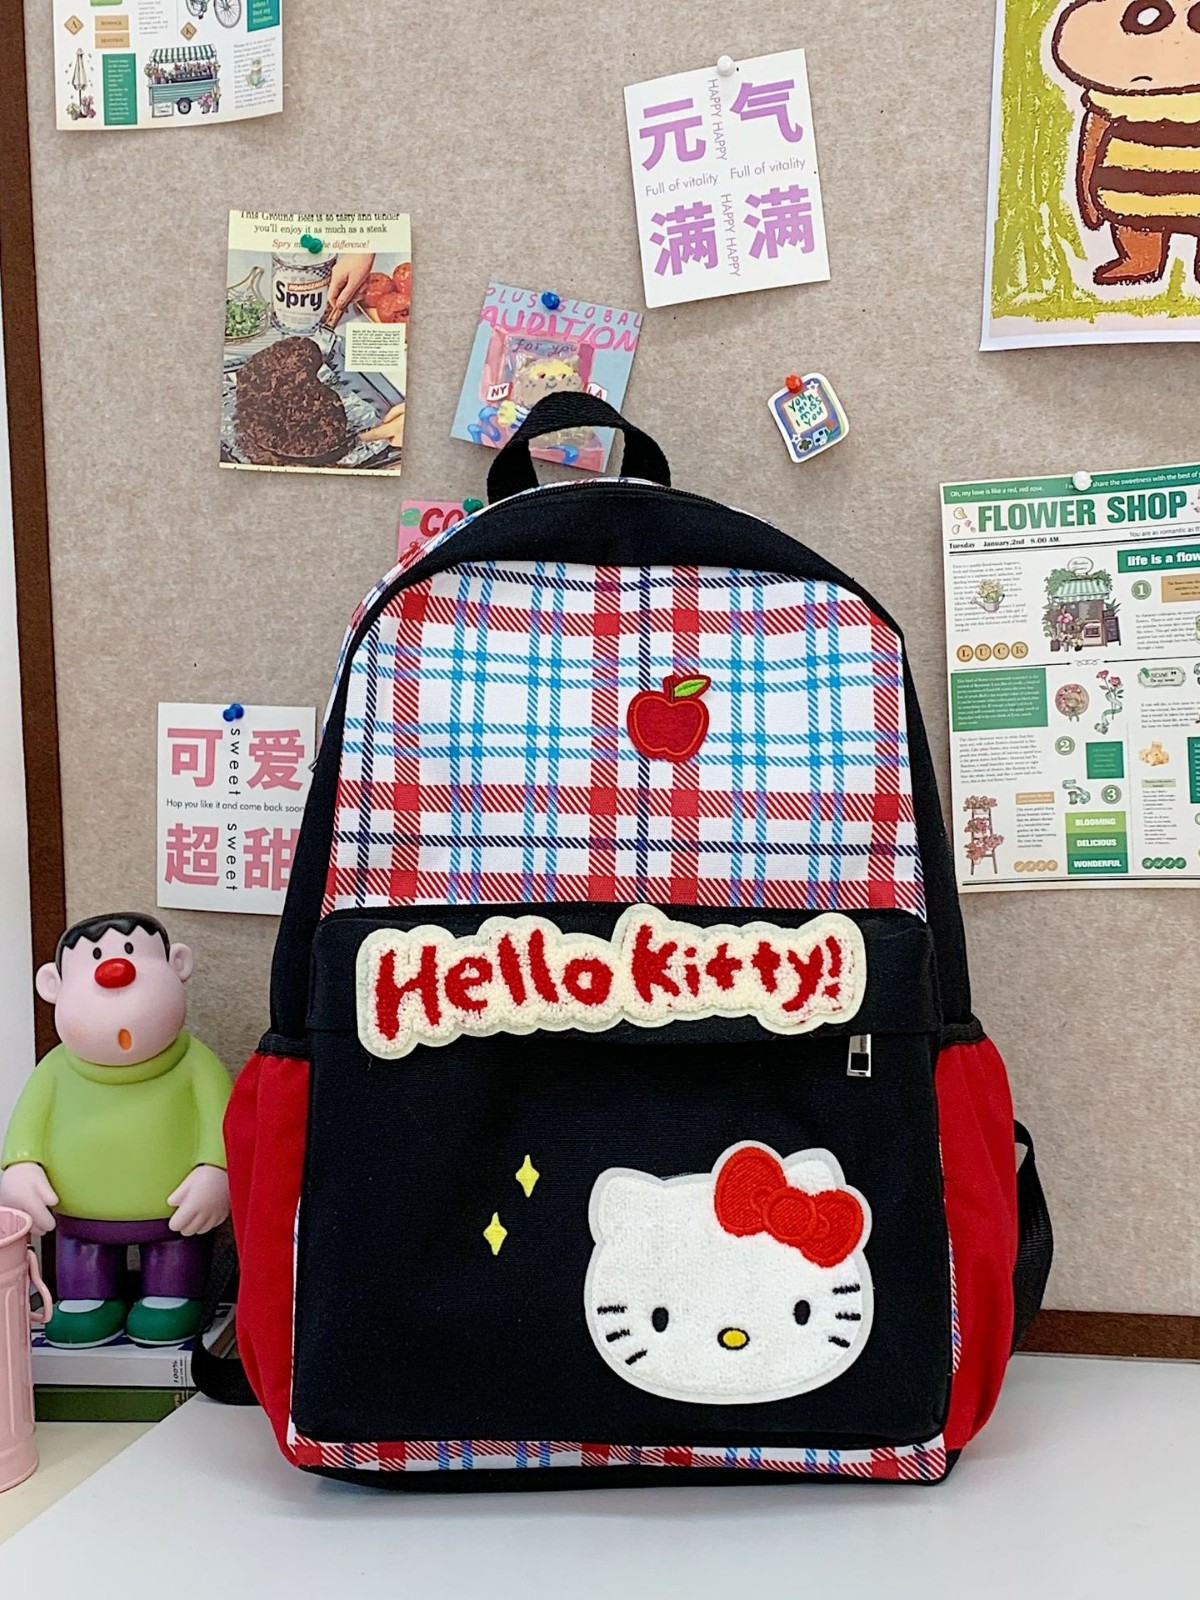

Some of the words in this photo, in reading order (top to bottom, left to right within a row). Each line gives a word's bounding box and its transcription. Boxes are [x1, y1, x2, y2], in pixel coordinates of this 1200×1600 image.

[707, 78, 722, 118] HAPPY
[639, 97, 706, 171] 元
[730, 79, 803, 143] 气
[712, 122, 728, 161] HAPPY
[645, 183, 664, 196] Full
[668, 179, 680, 192] of
[682, 173, 718, 190] vitality
[730, 165, 751, 180] Full
[754, 162, 766, 175] of
[766, 158, 806, 176] vitality
[720, 193, 736, 233] HAPPY
[254, 224, 277, 234] you'll
[280, 226, 302, 235] enjoy
[305, 225, 311, 233] it
[325, 225, 346, 234] much
[366, 224, 387, 233] steak
[272, 239, 291, 250] Spry
[332, 240, 370, 250] difference!
[649, 200, 718, 276] 满
[744, 184, 815, 260] 满
[725, 237, 741, 277] HAPPY
[275, 280, 322, 312] Spry
[480, 306, 640, 353] AUDITION
[491, 385, 506, 397] NY
[978, 500, 1096, 532] FLOWER
[1107, 490, 1187, 524] SHOP
[1127, 555, 1148, 567] life
[1151, 554, 1162, 565] is
[1165, 555, 1173, 563] a
[1137, 584, 1146, 596] 1
[167, 728, 223, 788] 可
[246, 729, 305, 792] 爱
[1060, 738, 1070, 752] 2
[228, 728, 241, 796] sweet
[166, 798, 182, 809] Hop
[184, 801, 198, 810] you
[200, 799, 214, 809] like
[215, 800, 221, 809] it
[222, 801, 238, 810] and
[239, 803, 262, 811] come
[264, 802, 283, 812] back
[1106, 788, 1116, 801] 3
[1075, 817, 1116, 826] BLOOMING
[164, 823, 220, 886] 超
[226, 823, 238, 891] sweet
[1076, 838, 1117, 847] DELICIOUS
[1074, 860, 1122, 868] WONDERFUL
[373, 926, 615, 1042] Hello
